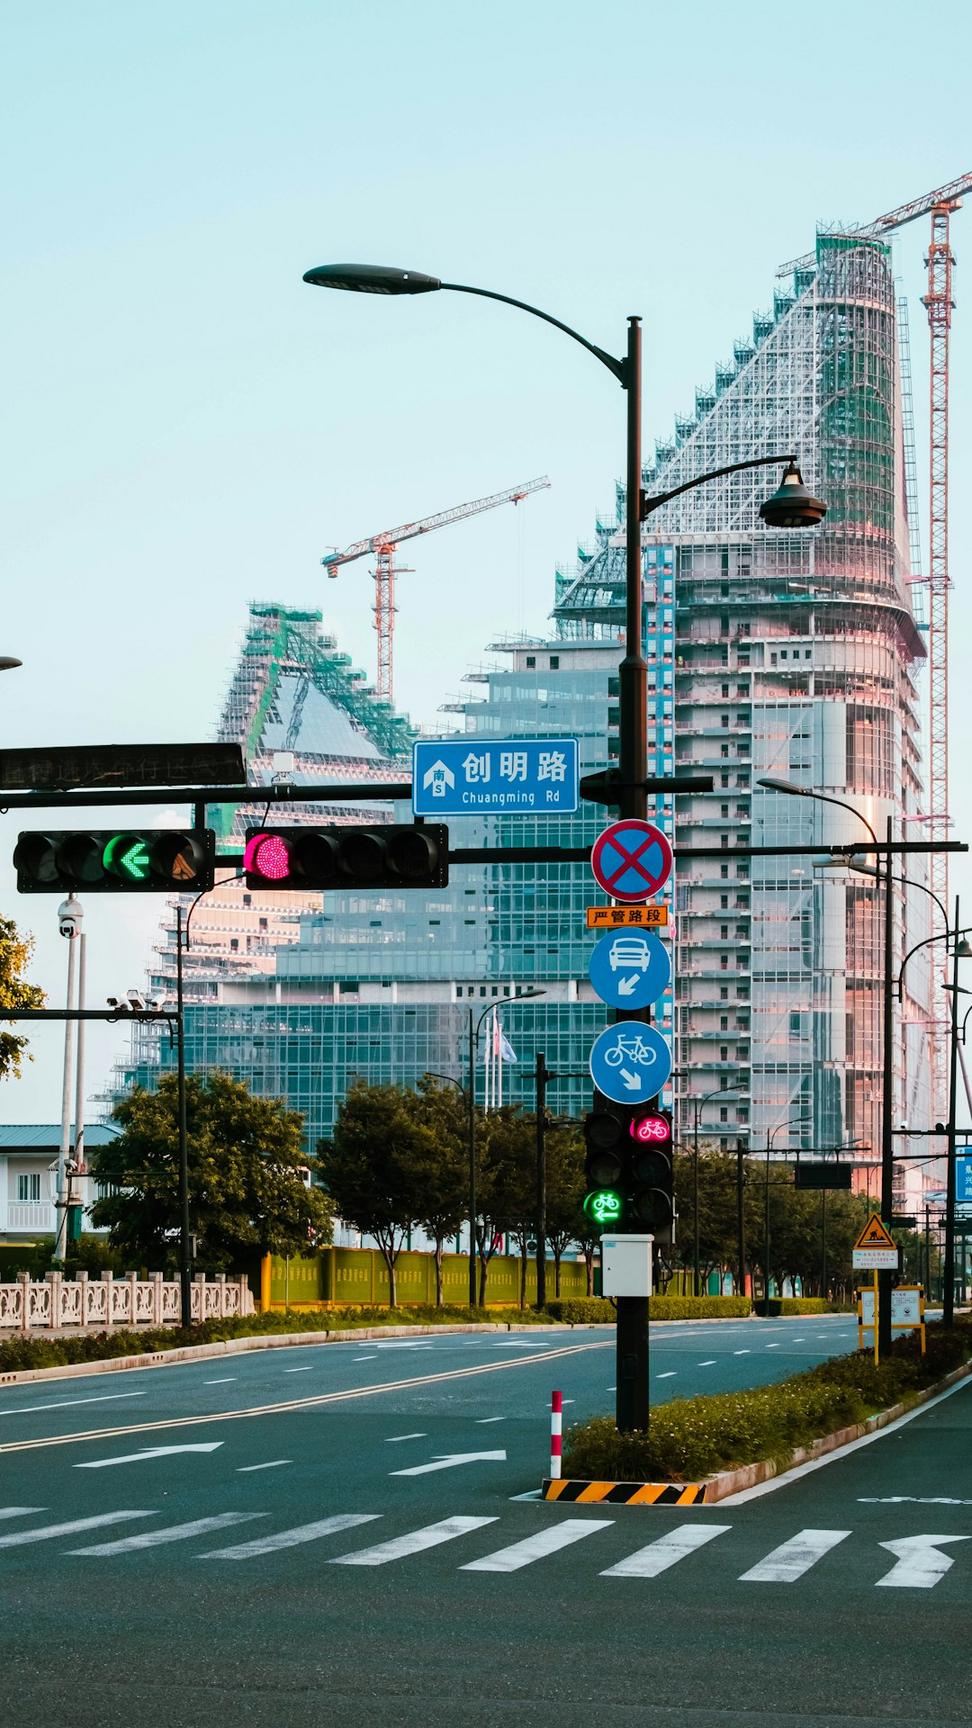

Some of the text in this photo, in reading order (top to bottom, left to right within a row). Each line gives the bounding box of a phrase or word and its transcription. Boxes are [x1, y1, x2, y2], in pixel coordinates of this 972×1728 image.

[461, 751, 568, 783] 创明路
[433, 769, 445, 782] 南
[435, 784, 443, 794] S
[462, 790, 561, 806] Chuangming Rd
[593, 909, 661, 924] 严管路段
